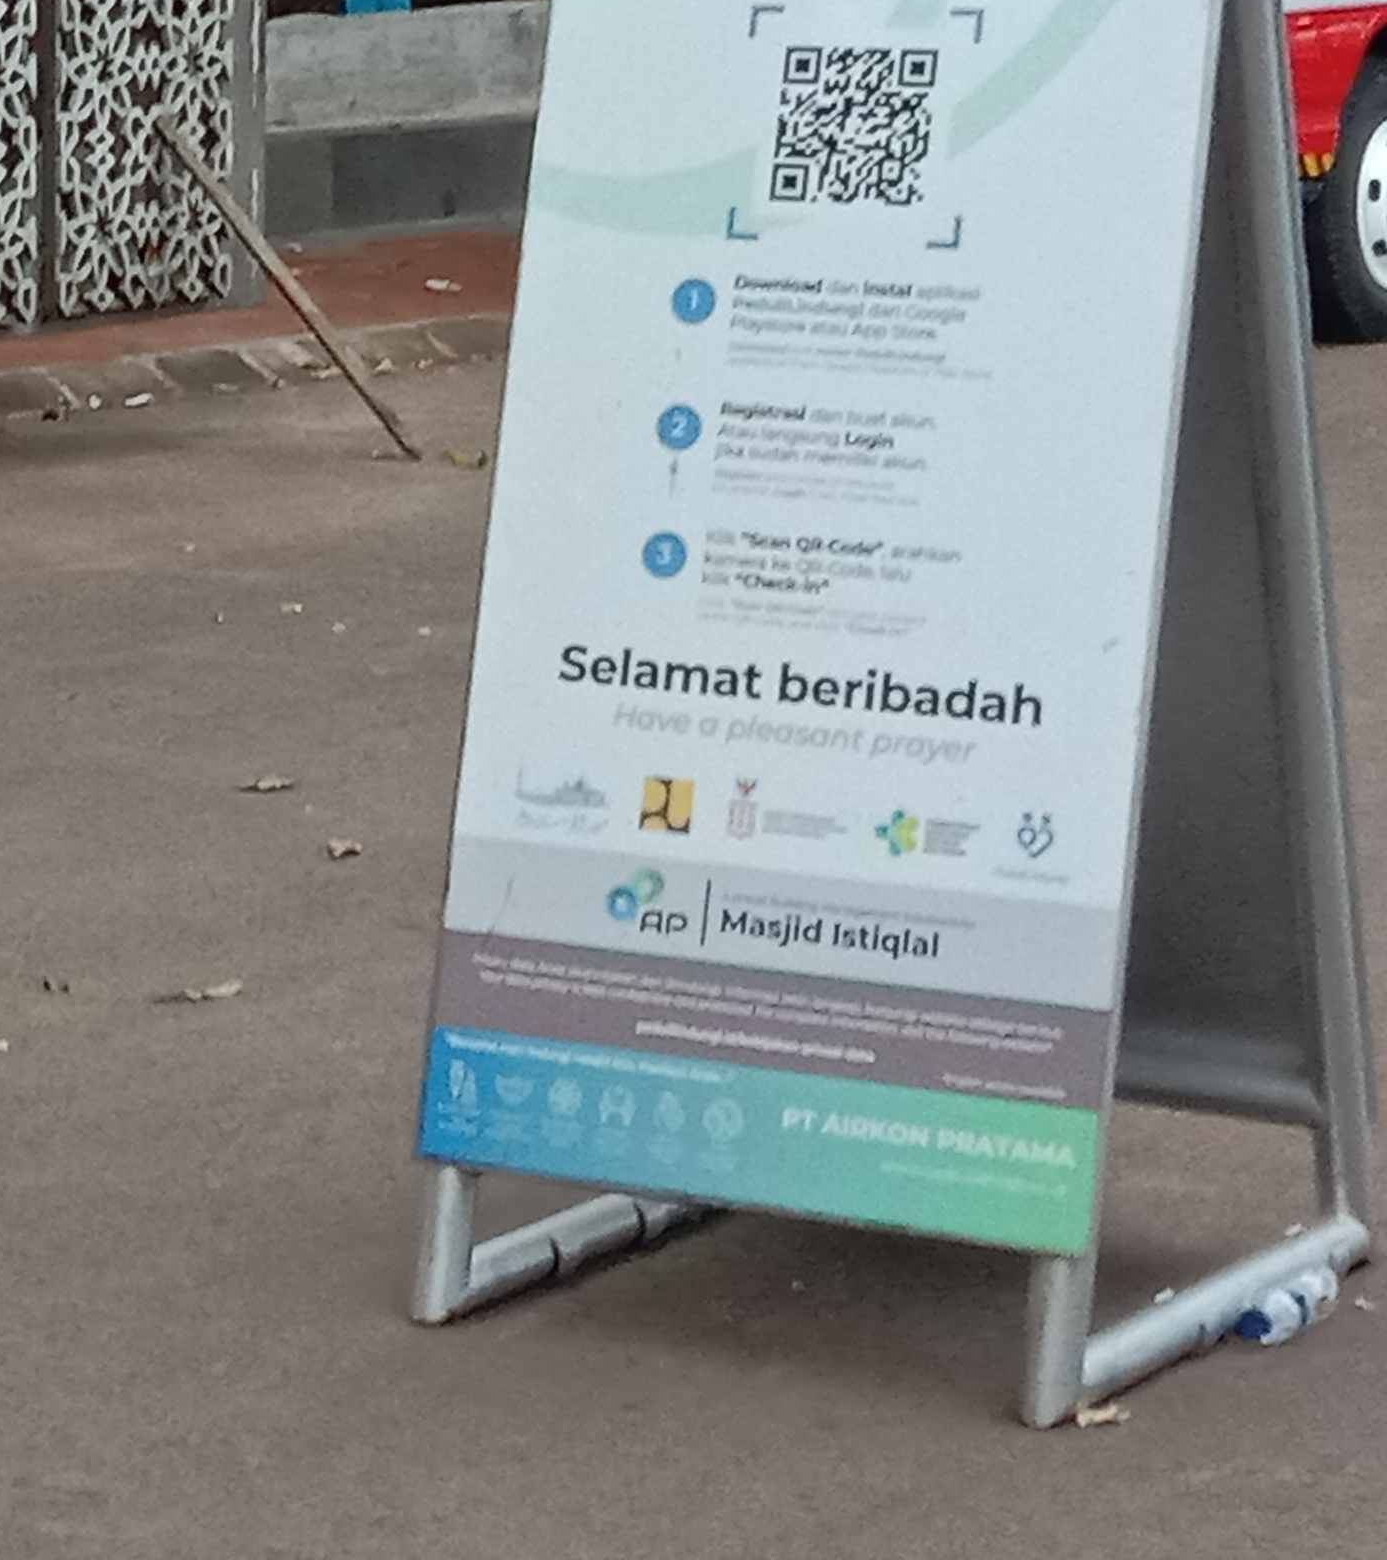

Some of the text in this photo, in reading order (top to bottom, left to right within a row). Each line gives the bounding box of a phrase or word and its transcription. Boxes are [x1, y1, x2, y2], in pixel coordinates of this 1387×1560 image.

[672, 411, 687, 437] 2
[658, 541, 673, 566] 3
[558, 644, 1043, 728] Selamat beribadah
[611, 702, 977, 768] Have a pleasant prayer
[720, 908, 823, 948] Masjid
[831, 923, 940, 961] Istiqlal
[782, 1106, 818, 1132] PT
[936, 1127, 1076, 1167] PRATAMA
